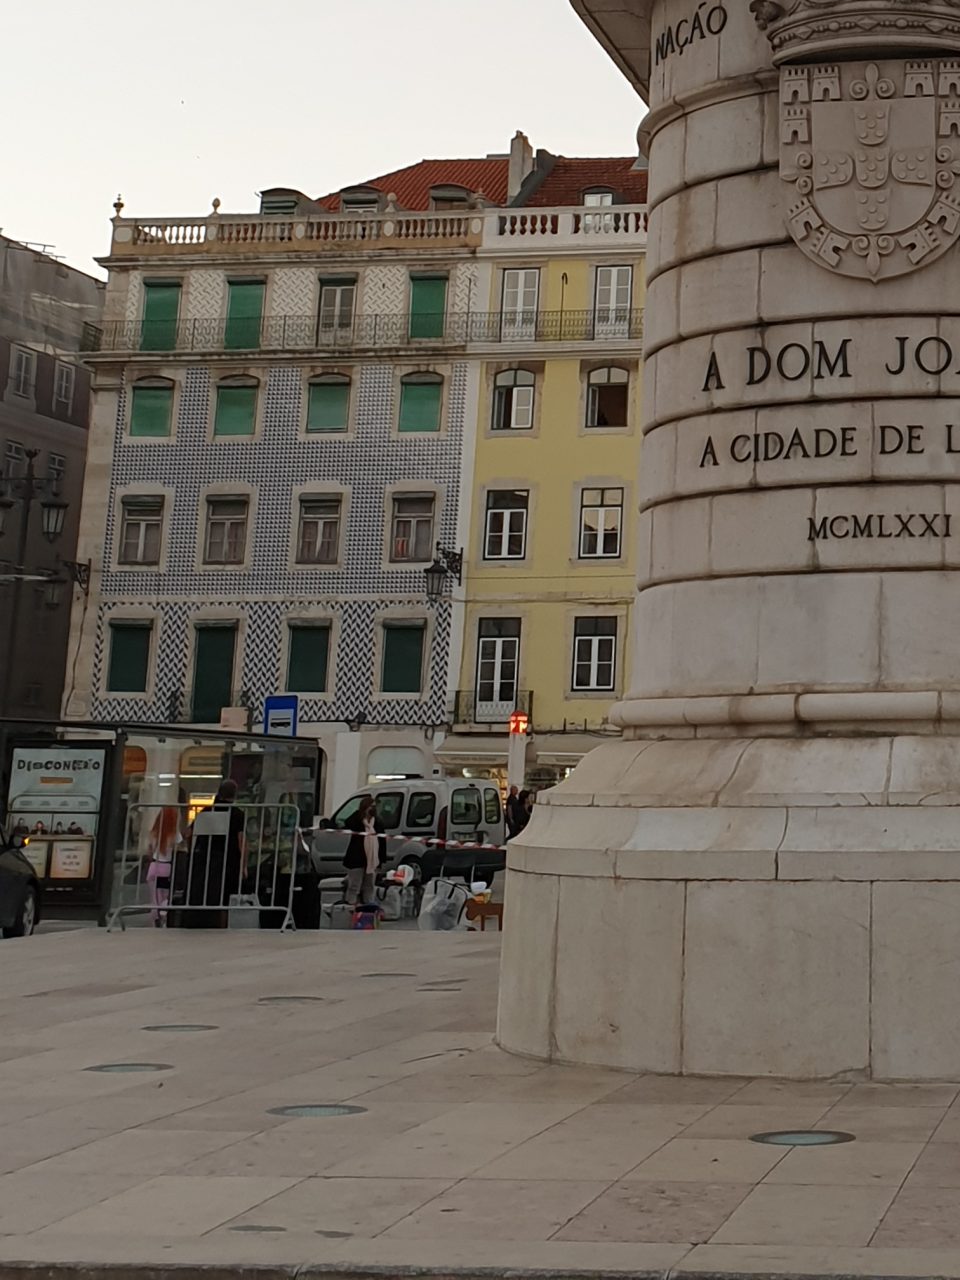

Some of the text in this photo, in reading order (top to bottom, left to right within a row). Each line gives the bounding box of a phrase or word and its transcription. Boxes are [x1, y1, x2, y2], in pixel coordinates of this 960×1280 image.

[702, 351, 725, 391] A
[746, 339, 852, 385] DOM
[700, 436, 719, 467] A
[730, 427, 858, 462] CIDADE
[879, 425, 925, 454] DE
[807, 514, 952, 541] MCMLXXI
